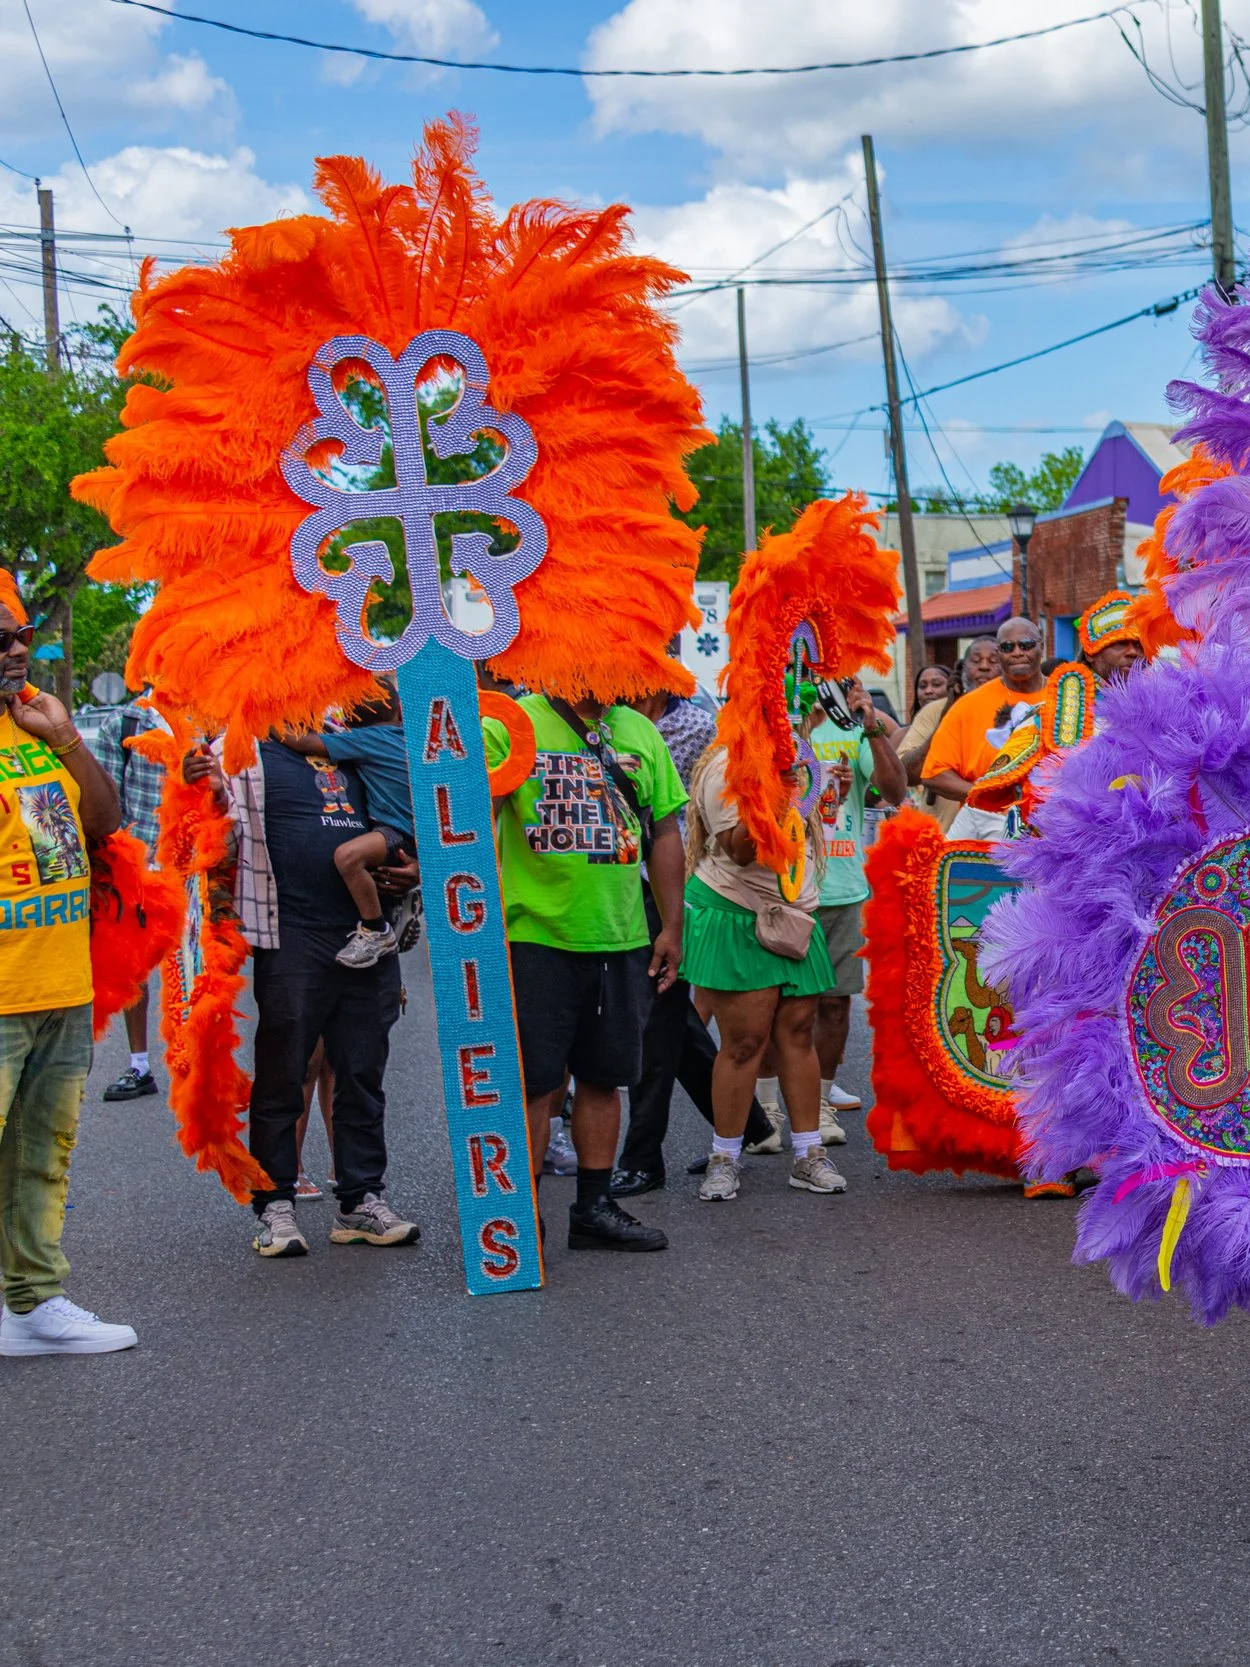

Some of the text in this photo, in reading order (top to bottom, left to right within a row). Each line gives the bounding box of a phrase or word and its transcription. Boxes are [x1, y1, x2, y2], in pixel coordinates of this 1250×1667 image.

[543, 777, 585, 802] IN
[536, 801, 601, 827] THE
[525, 825, 613, 852] HOLE
[823, 840, 856, 857] IORS
[423, 696, 520, 1281] ALGIERS
